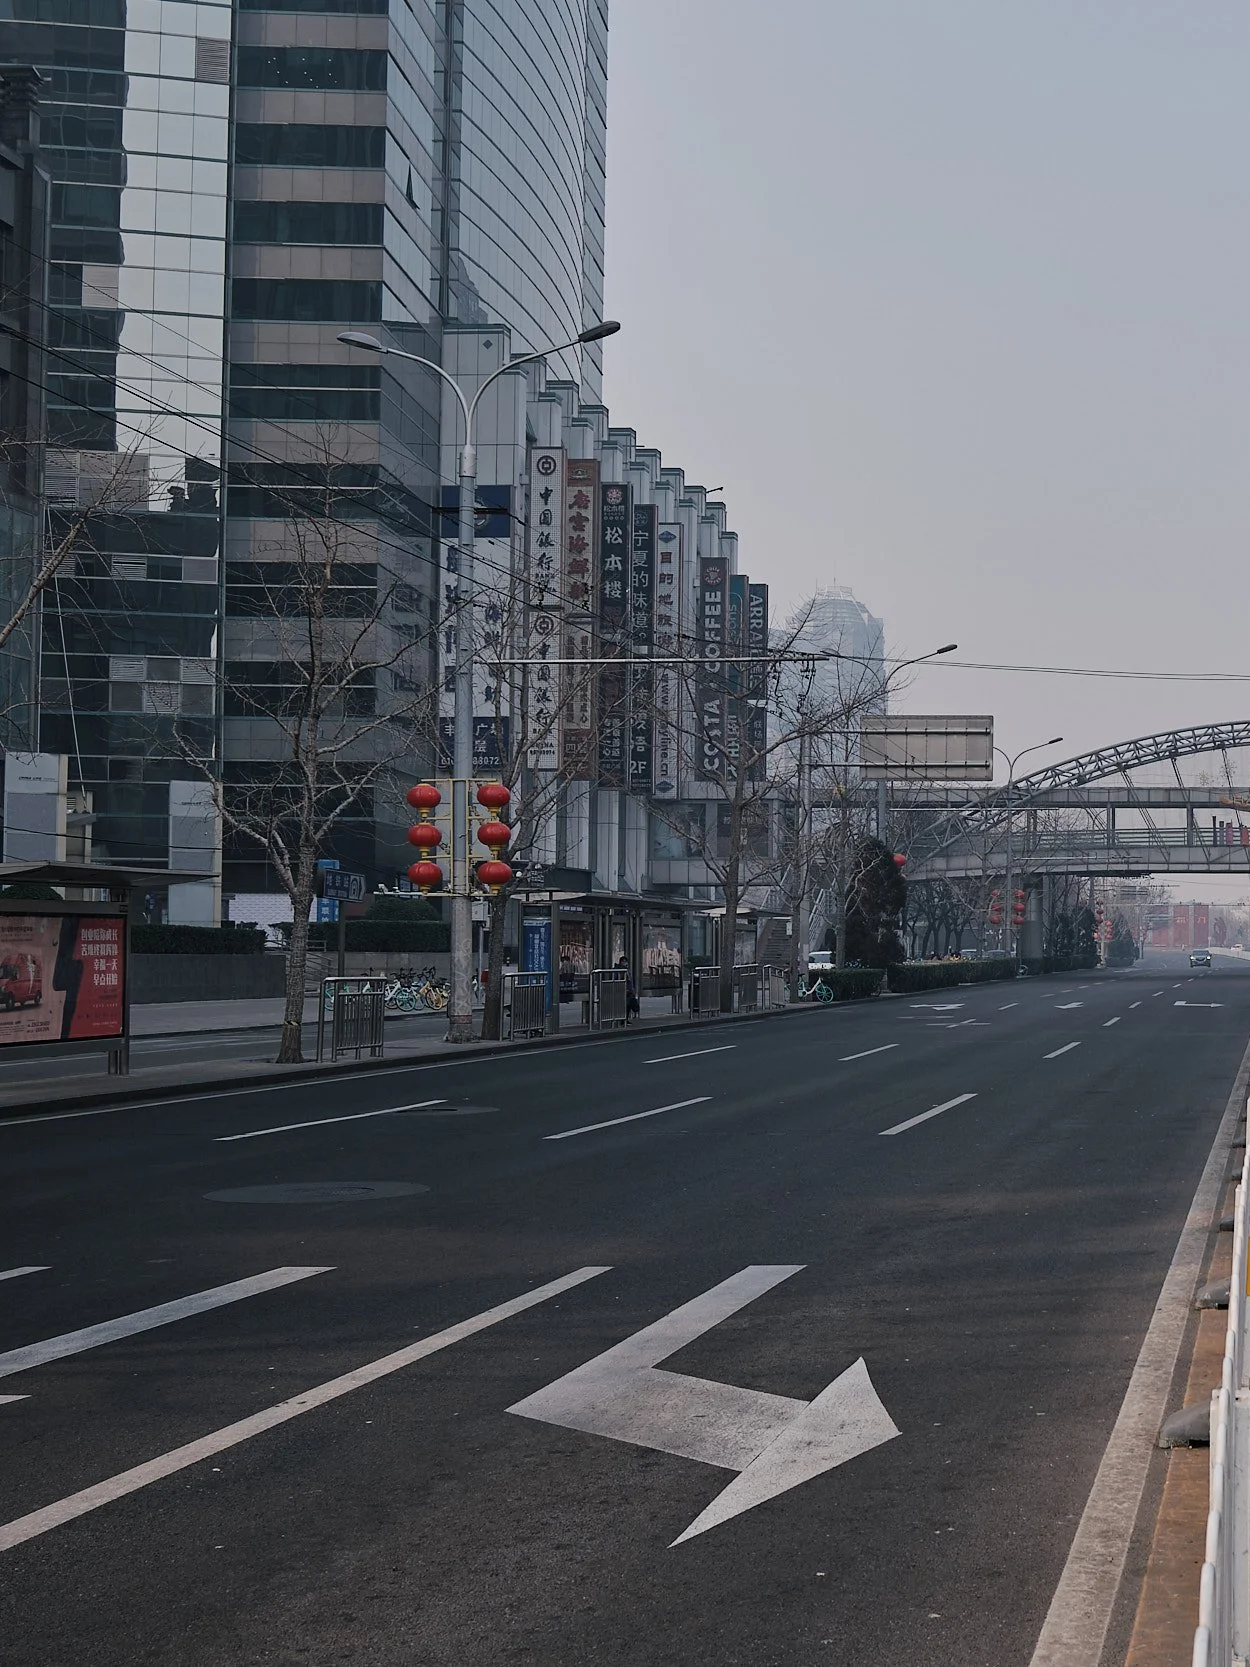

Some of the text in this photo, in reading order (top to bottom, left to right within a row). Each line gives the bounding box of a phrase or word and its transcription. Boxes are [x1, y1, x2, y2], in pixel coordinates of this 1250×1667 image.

[604, 526, 623, 599] 松本楼
[704, 590, 721, 673] COFFEE
